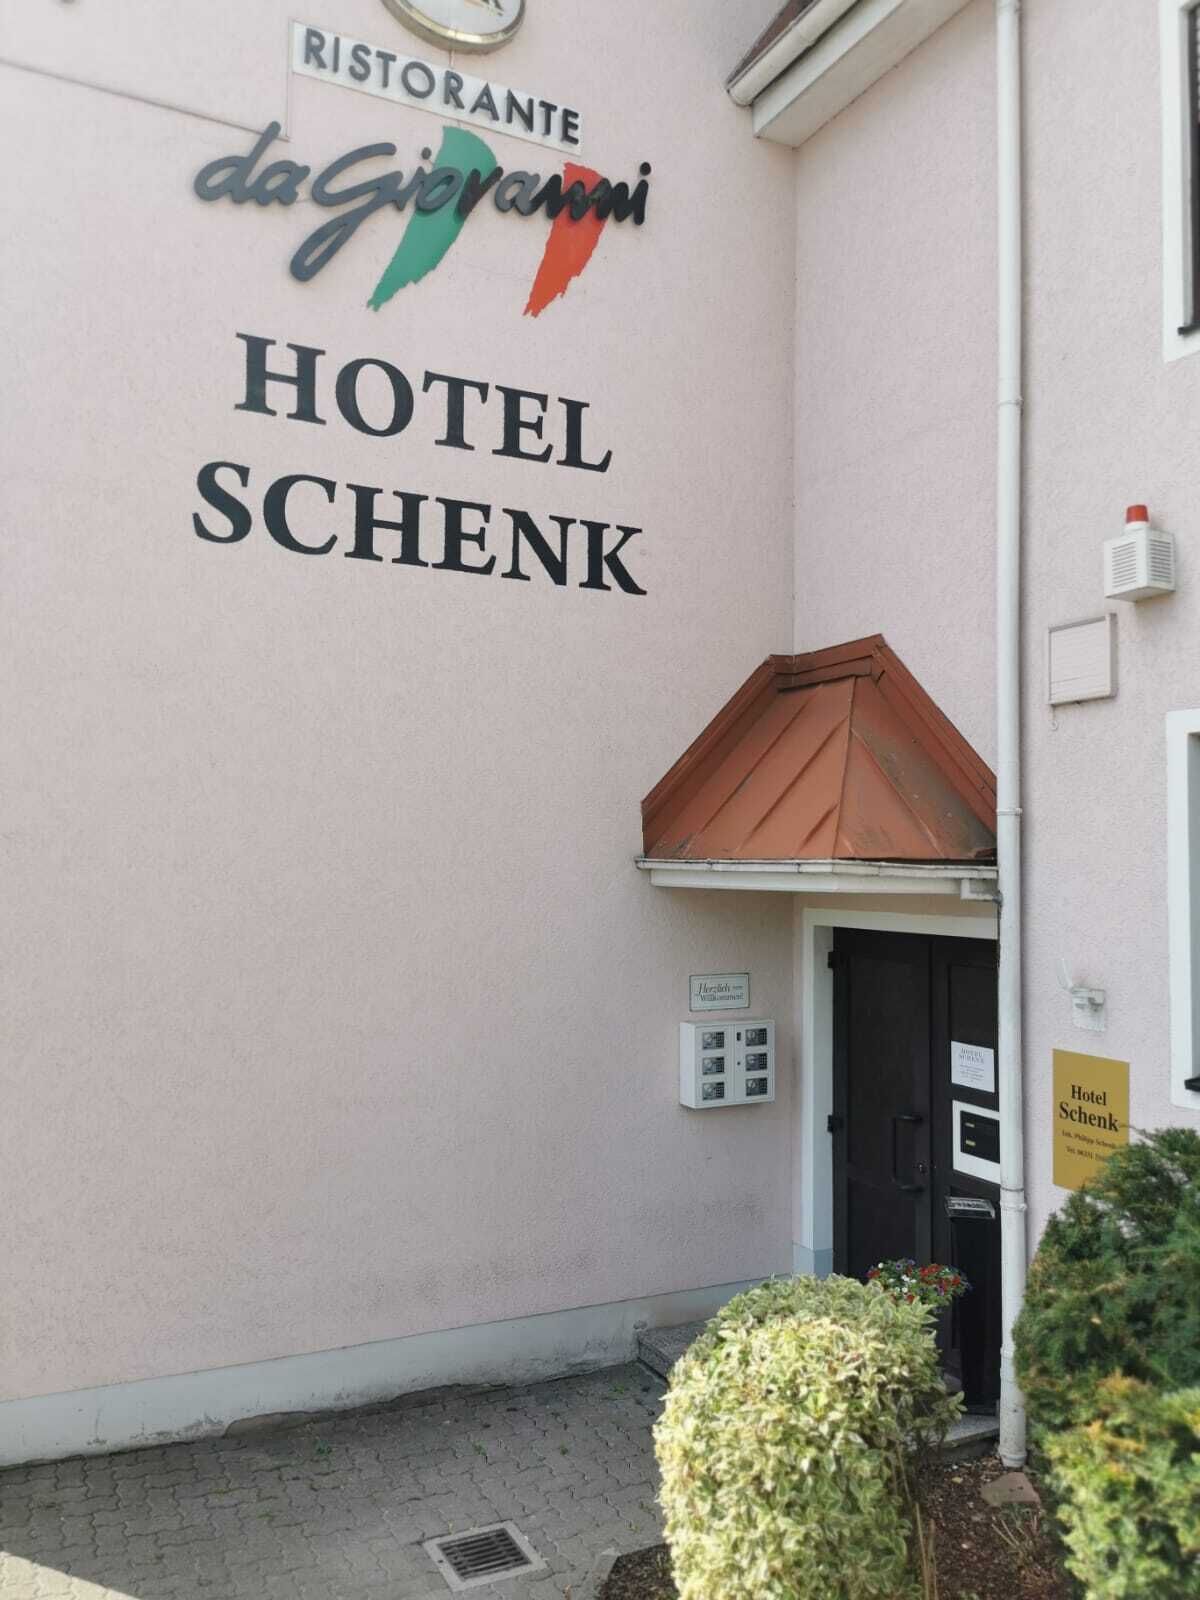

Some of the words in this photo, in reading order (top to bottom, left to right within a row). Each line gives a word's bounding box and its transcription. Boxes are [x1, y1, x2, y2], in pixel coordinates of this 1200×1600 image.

[303, 28, 580, 146] RISTORANTE
[234, 332, 613, 473] HOTEL
[192, 461, 648, 596] SCHENK
[1059, 1101, 1119, 1132] Schenk
[1071, 1084, 1107, 1106] Hotel
